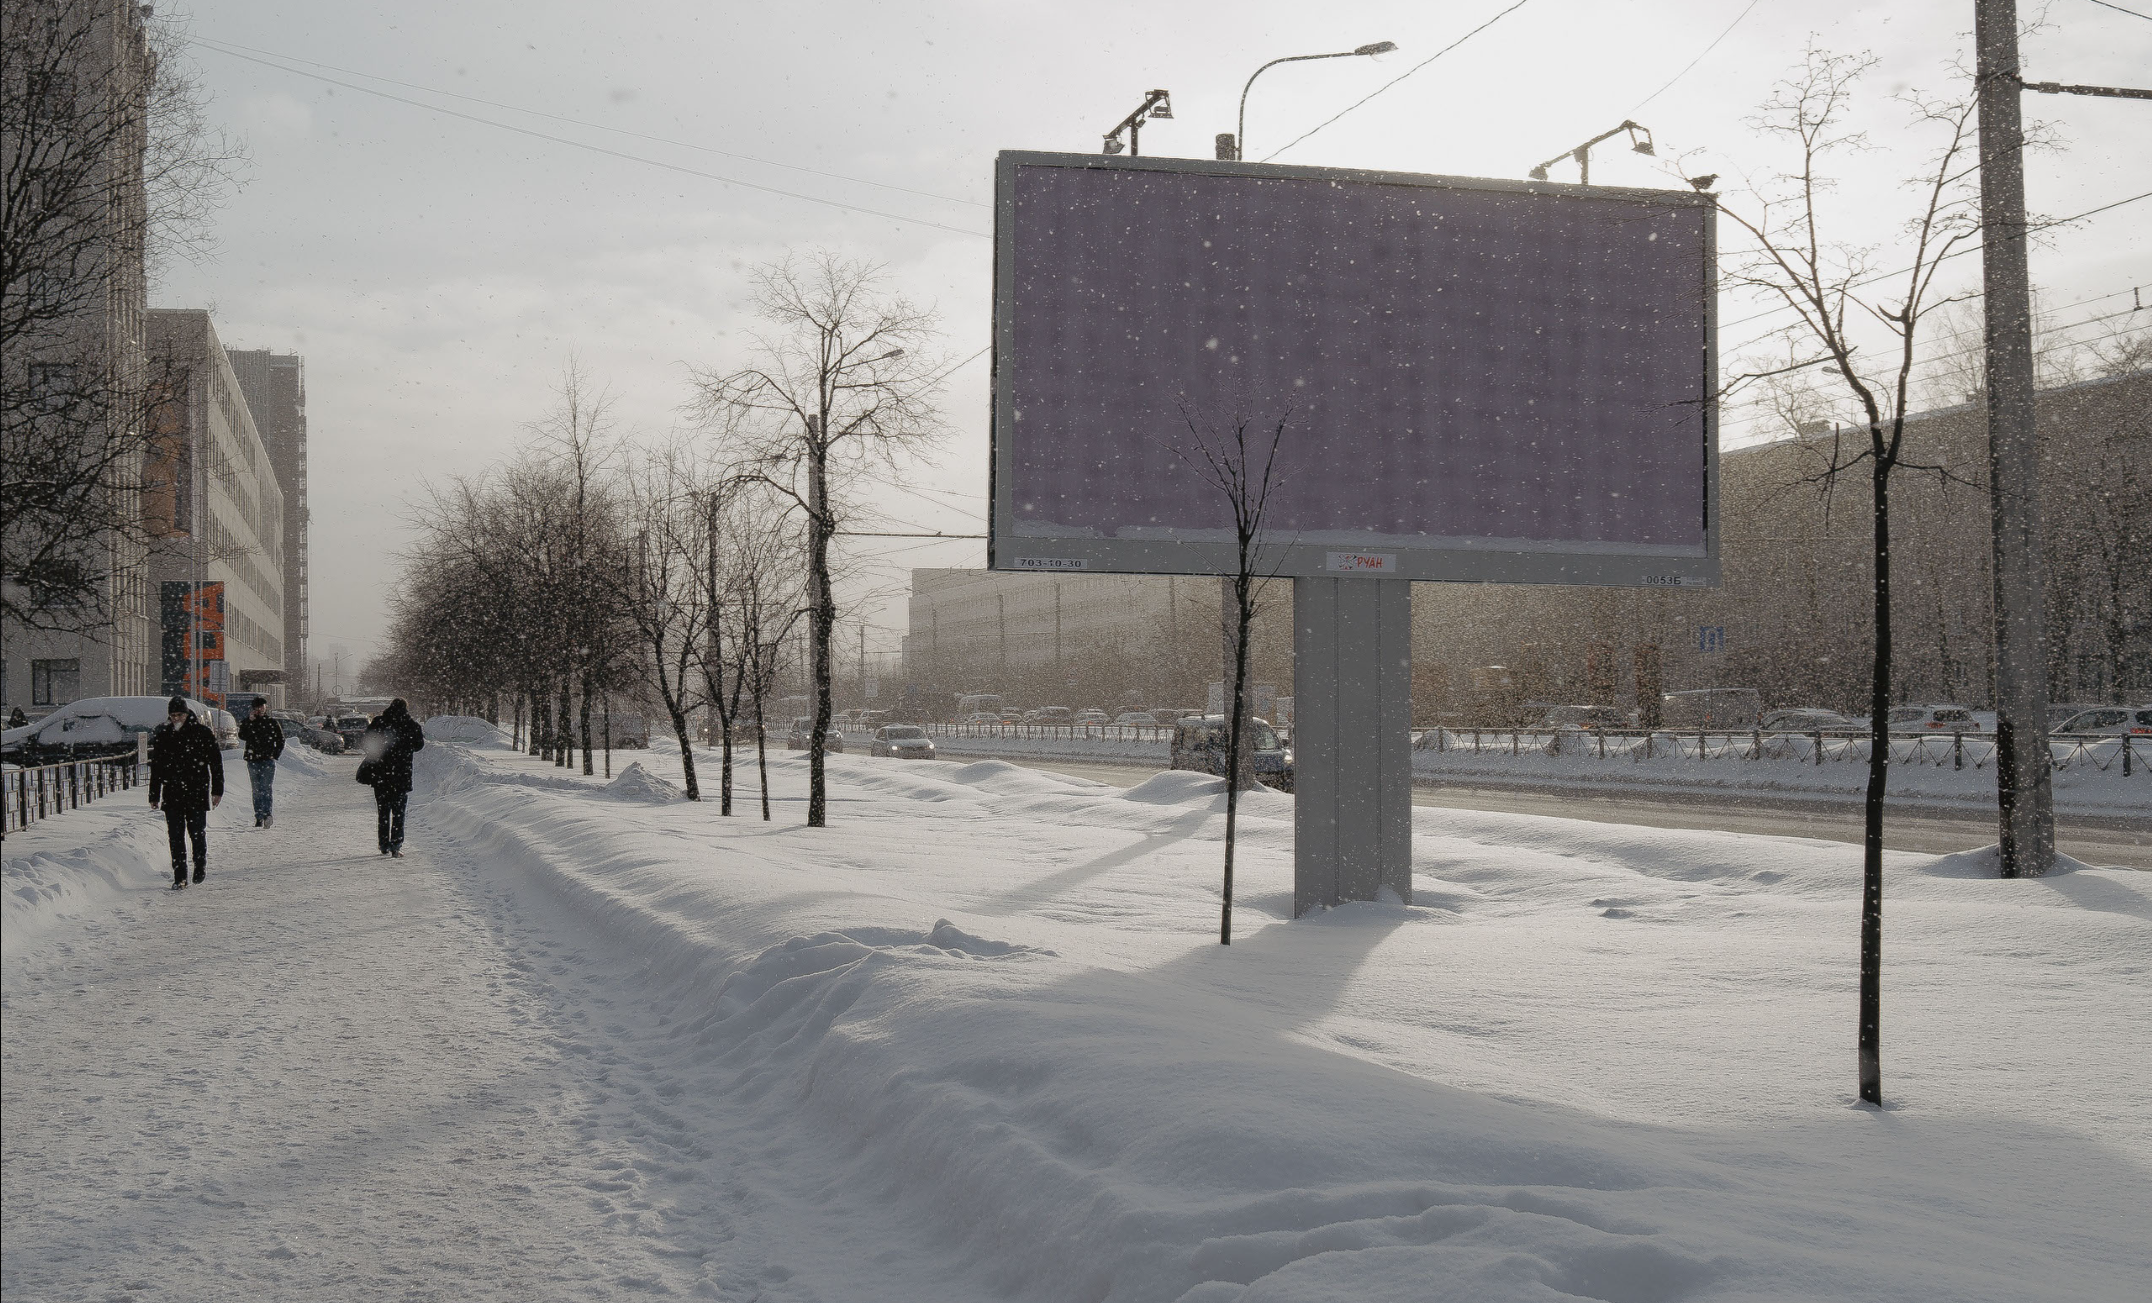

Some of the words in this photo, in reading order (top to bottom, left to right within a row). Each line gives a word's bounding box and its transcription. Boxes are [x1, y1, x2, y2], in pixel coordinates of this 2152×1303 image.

[1020, 559, 1082, 567] 703-10-30
[1357, 556, 1383, 569] РУАН
[1646, 575, 1682, 585] 0053Б
